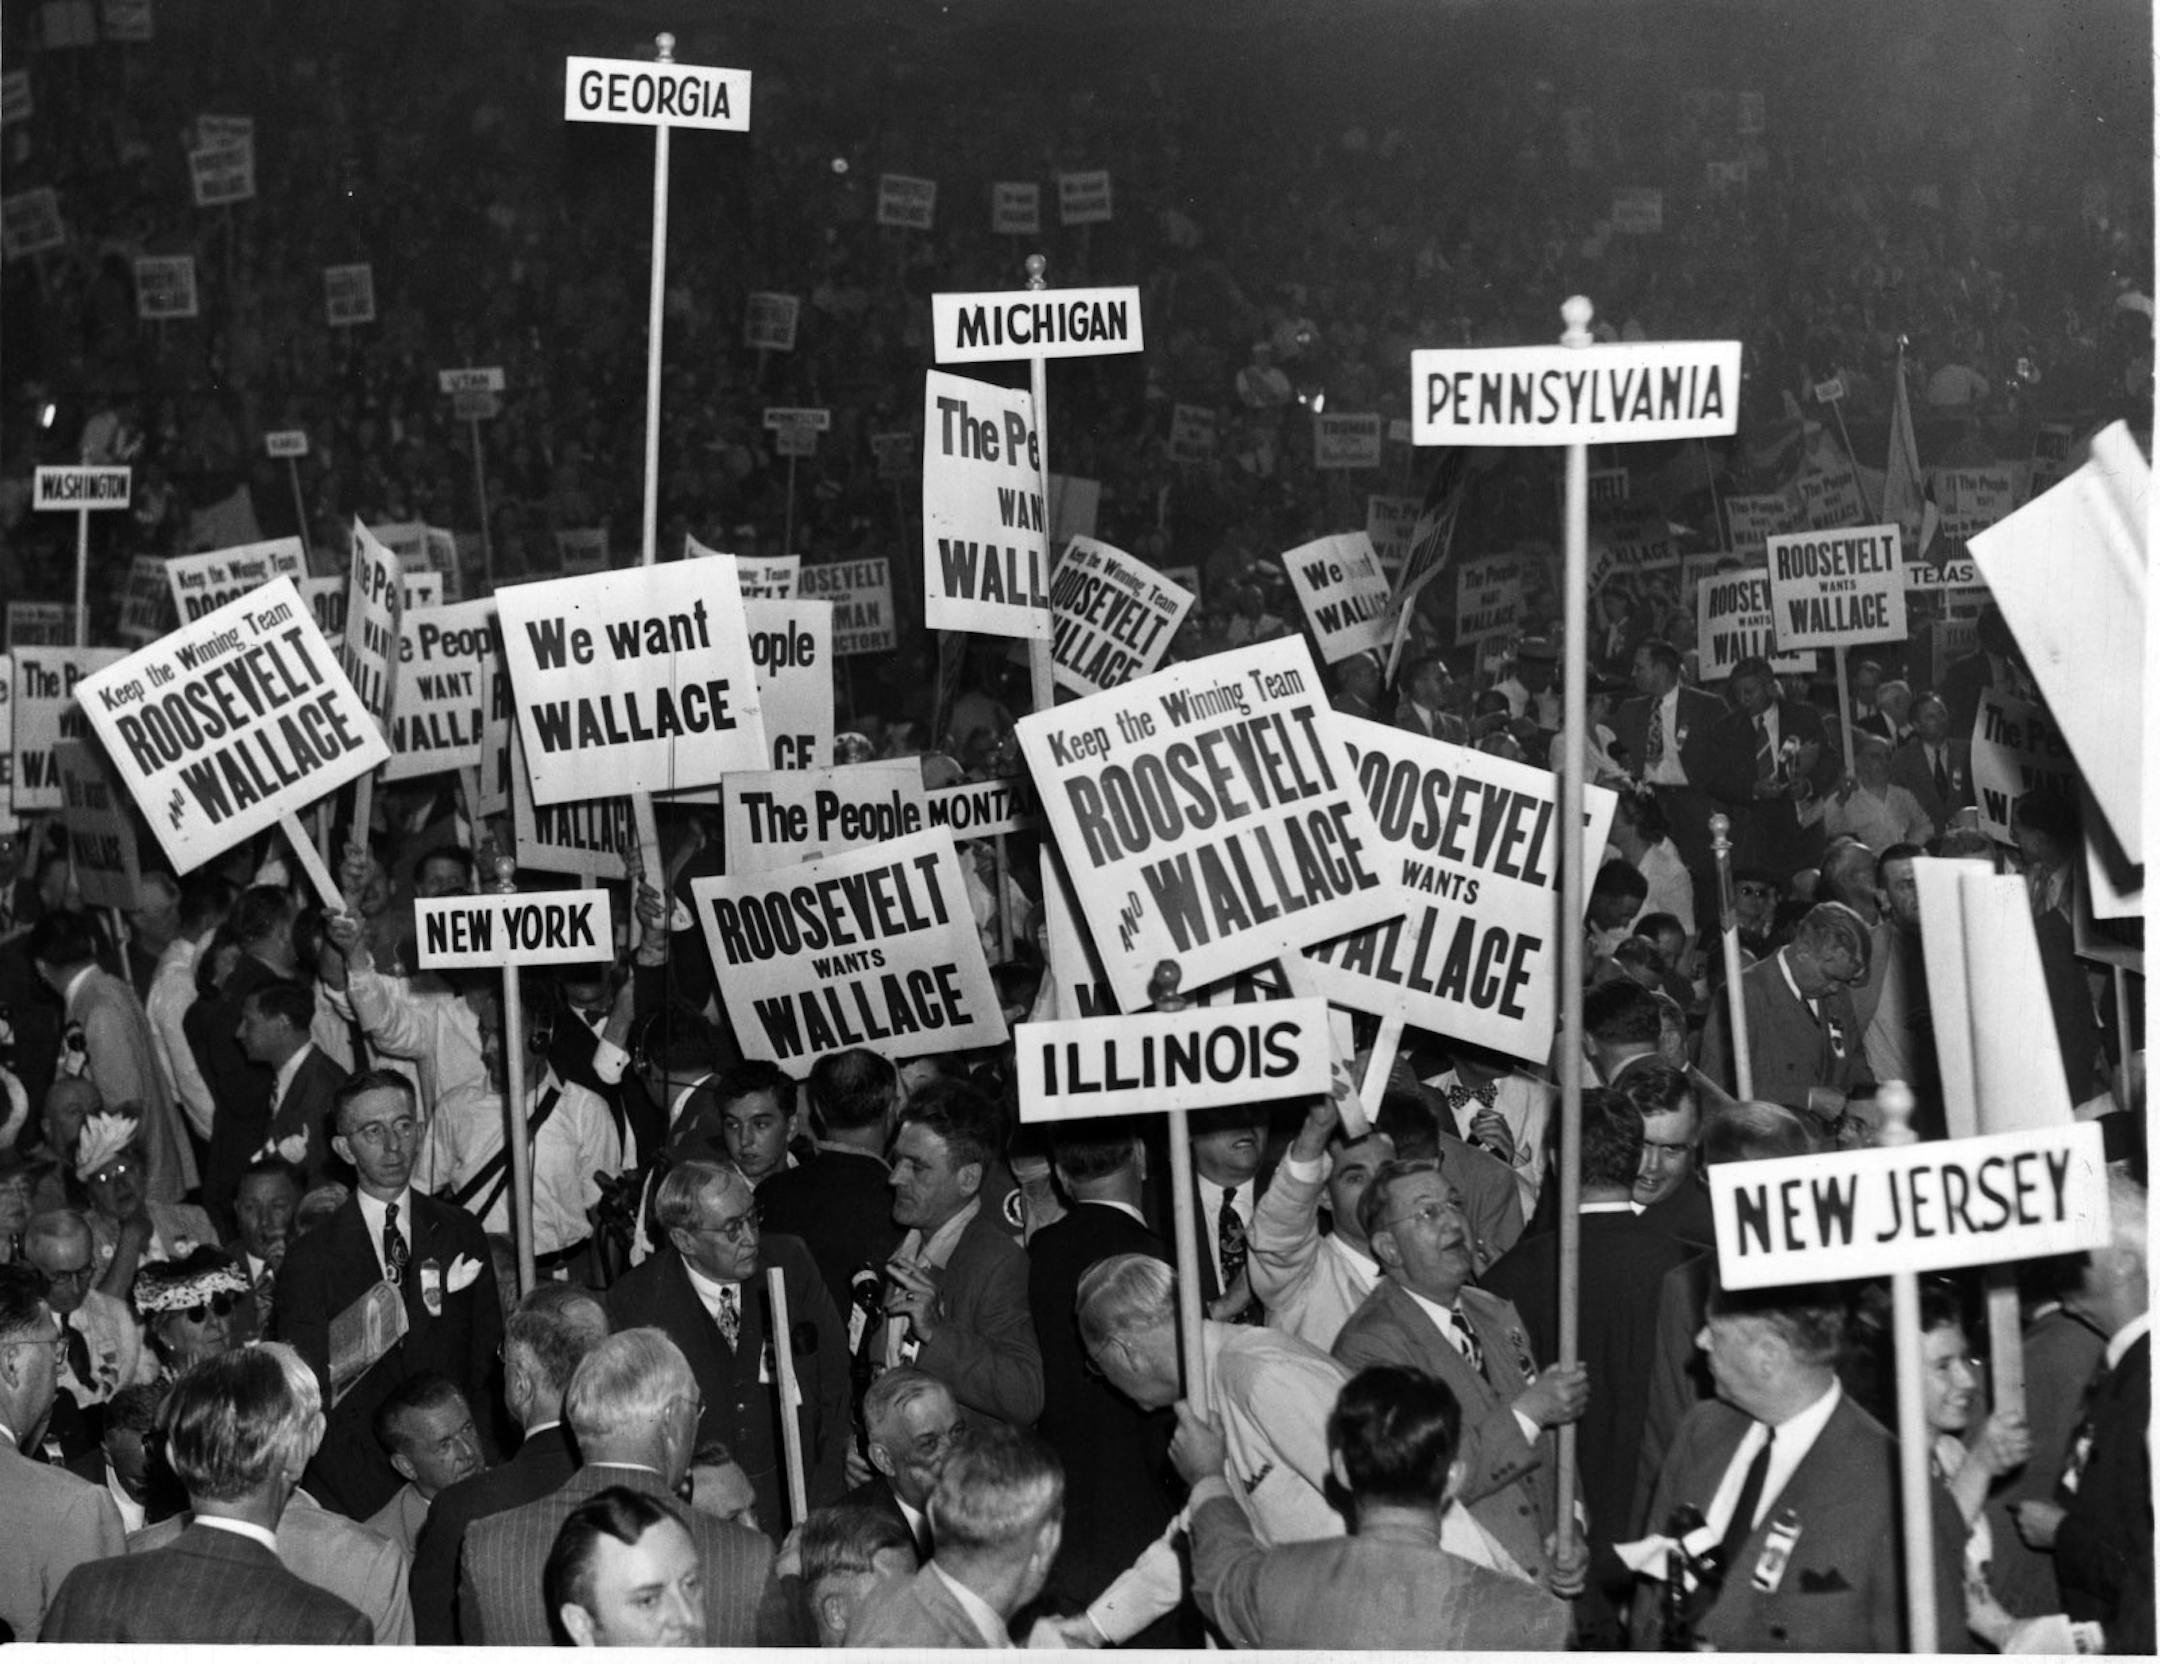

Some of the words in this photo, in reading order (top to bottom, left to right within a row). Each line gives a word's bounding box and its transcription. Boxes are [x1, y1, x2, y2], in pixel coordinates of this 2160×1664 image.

[579, 70, 731, 119] GEORGIA
[956, 300, 1128, 348] MICHIGAN
[1427, 364, 1723, 425] PENNSYLVANIA
[936, 395, 1000, 463] The
[42, 474, 128, 499] WASHINGTON
[997, 486, 1045, 534] WAN
[801, 560, 885, 594] OSEVELT
[1302, 559, 1344, 591] We
[1776, 535, 1893, 580] ROOSEVELT
[1910, 565, 1974, 585] TEXAS
[1103, 556, 1146, 598] Winning
[1148, 583, 1179, 616] Team
[1818, 581, 1857, 593] WANTS
[525, 617, 594, 671] We
[605, 598, 711, 660] want
[833, 602, 880, 631] MAN
[1788, 593, 1889, 635] WALLACE
[98, 679, 146, 712] Keep
[145, 662, 176, 690] the
[175, 627, 247, 672] Winning
[242, 602, 294, 636] Team
[749, 619, 815, 677] ople
[22, 661, 60, 698] The
[115, 626, 324, 776] ROOSEVELT
[416, 671, 473, 701] WANT
[531, 678, 737, 753] WALLACE
[1047, 726, 1111, 767] Keep
[1114, 709, 1156, 744] the
[1159, 681, 1251, 728] Winning
[1247, 668, 1305, 702] Team
[1985, 703, 2021, 748] The
[178, 689, 365, 826] WALLACE
[1063, 705, 1338, 869] ROOSEVELT
[740, 791, 808, 844] The
[815, 789, 922, 842] People
[1344, 741, 1591, 891] OOSEVEL
[1117, 890, 1144, 952] AND
[1140, 800, 1381, 954] WALLACE
[1401, 859, 1480, 905] WANTS
[425, 909, 492, 954] NEW
[502, 902, 596, 950] YORK
[711, 852, 949, 965] ROOSEVELT
[811, 948, 886, 979] WANTS
[753, 962, 974, 1060] WALLACE
[1042, 1021, 1302, 1097] ILLINOIS
[1733, 1174, 1859, 1257] NEW
[1875, 1148, 2070, 1243] JERSEY
